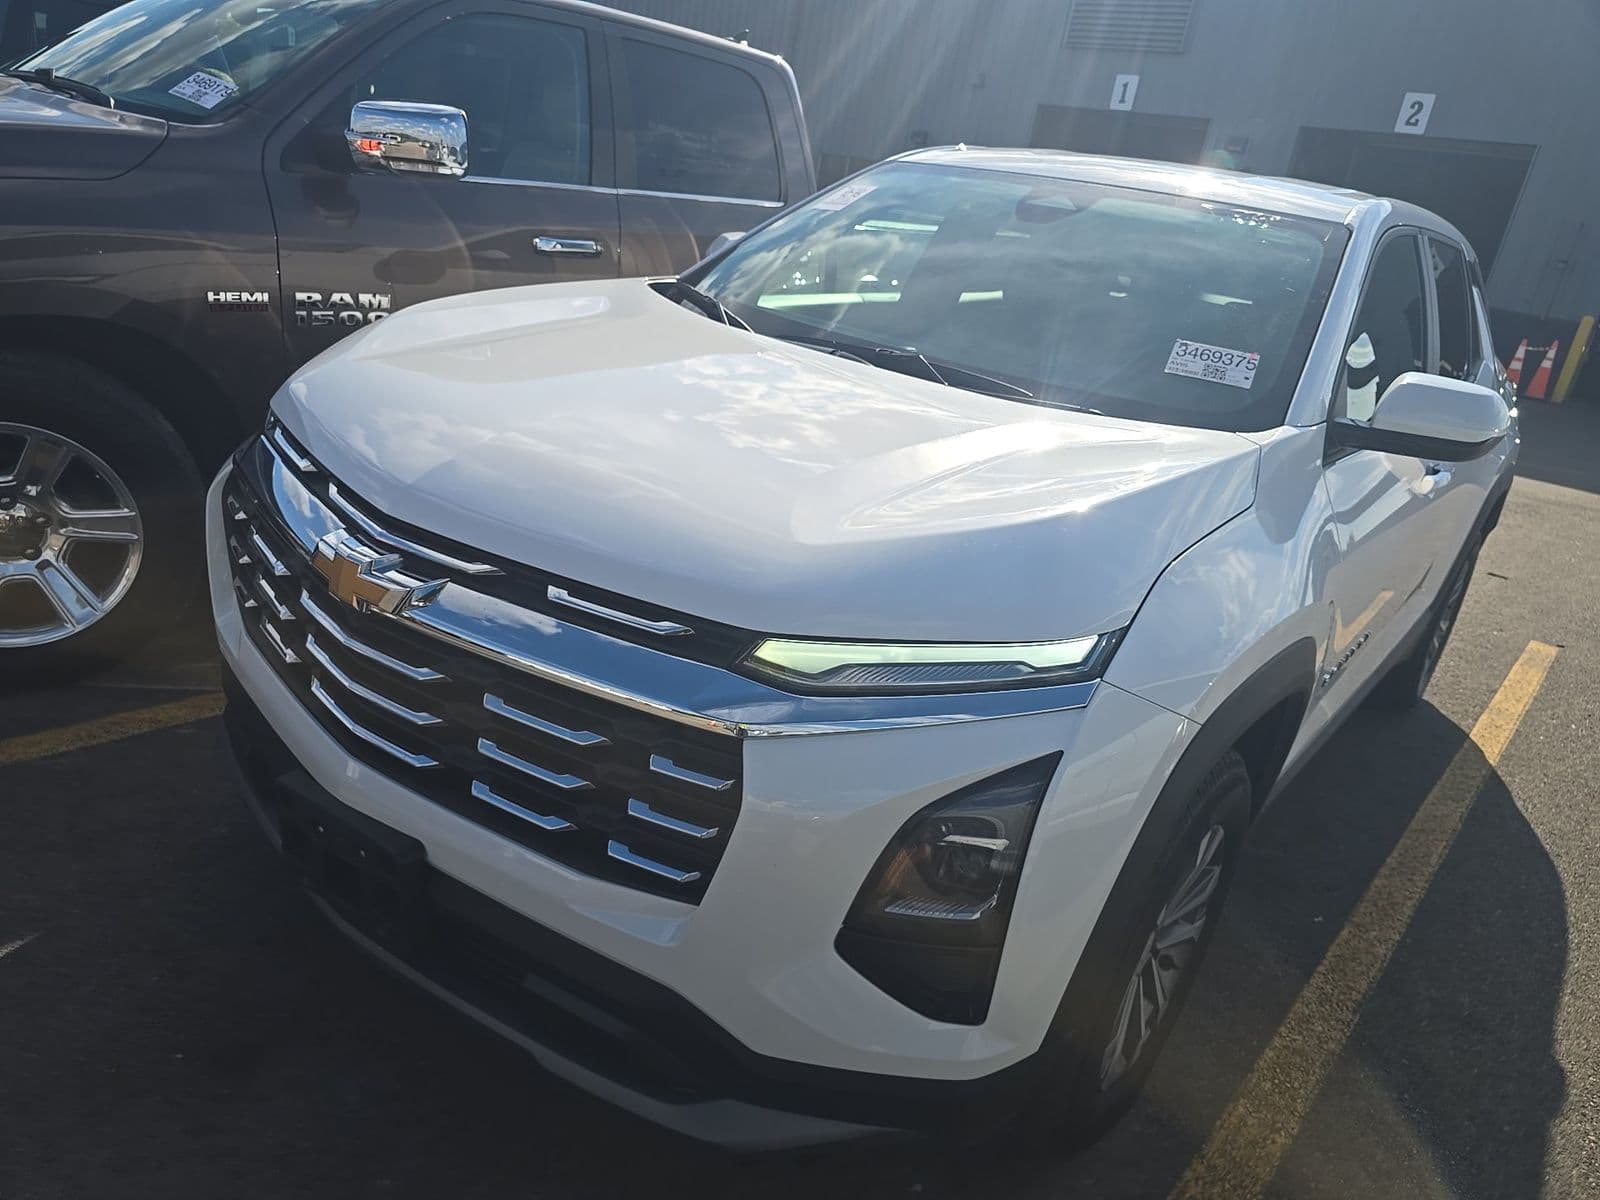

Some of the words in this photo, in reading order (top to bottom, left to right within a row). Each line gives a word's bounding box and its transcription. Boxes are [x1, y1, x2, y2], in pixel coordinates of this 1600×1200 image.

[1118, 81, 1130, 104] 1
[1404, 100, 1424, 127] 2
[207, 291, 270, 303] HEMI
[295, 292, 391, 309] RAM
[1175, 342, 1258, 371] 3469375
